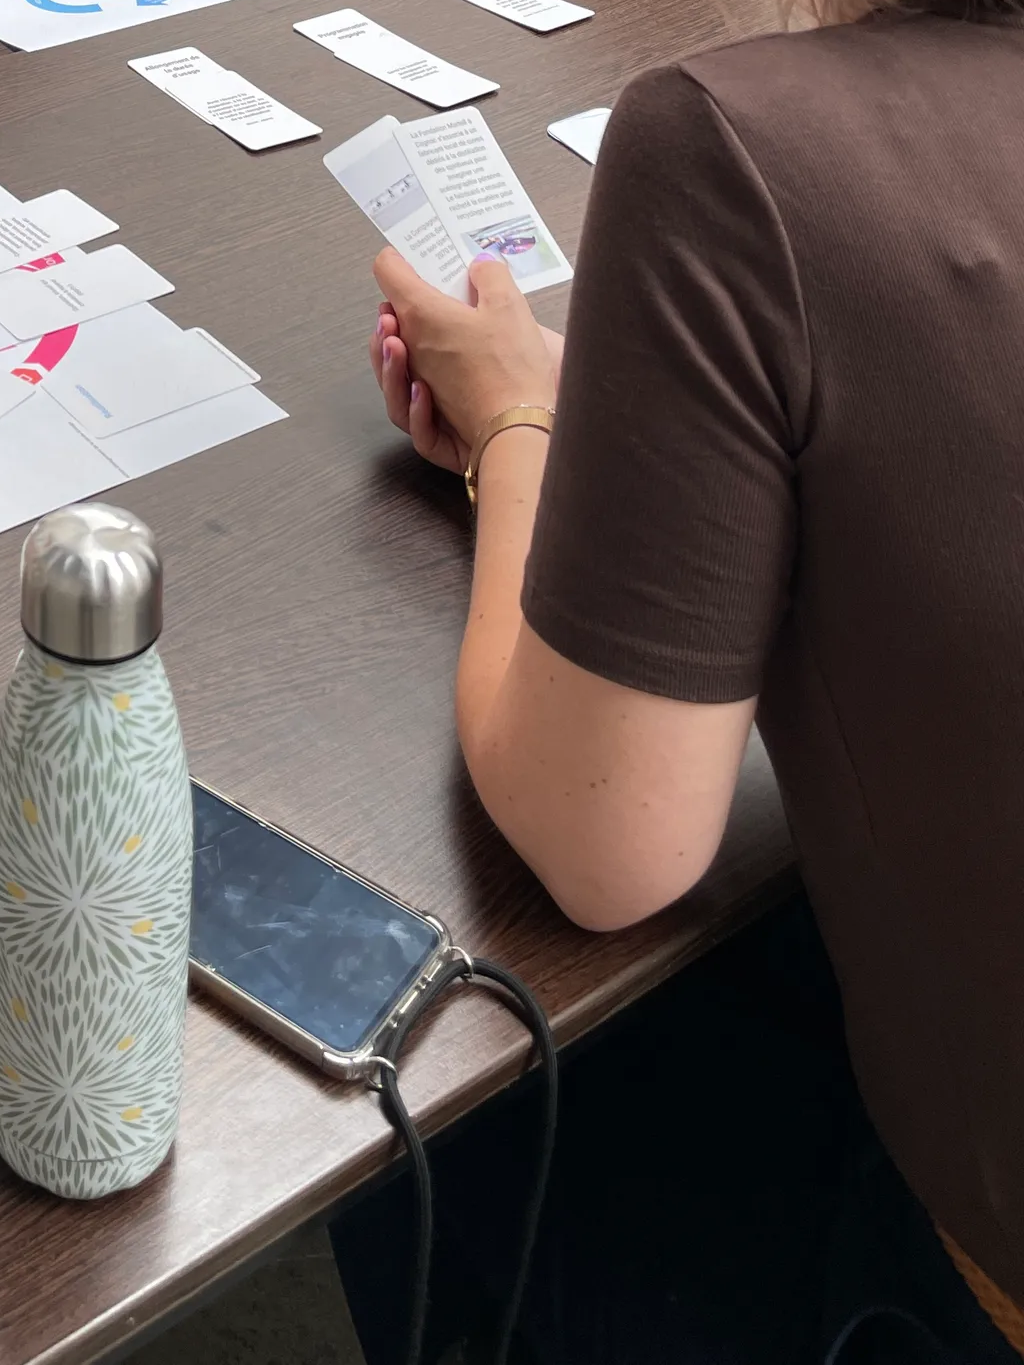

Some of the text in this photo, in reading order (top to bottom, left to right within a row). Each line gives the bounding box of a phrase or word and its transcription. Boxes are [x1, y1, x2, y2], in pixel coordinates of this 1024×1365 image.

[317, 20, 368, 39] Programmation
[144, 54, 200, 72] Allongement de
[172, 62, 194, 74] durée
[418, 124, 446, 136] Fondation
[414, 137, 437, 148] Cognac
[417, 145, 443, 157] fabricant
[443, 141, 458, 150] local
[473, 155, 487, 163] pour
[445, 194, 454, 202] Le
[477, 192, 500, 204] matière
[500, 189, 513, 197] pour
[456, 207, 485, 220] recyclage
[404, 232, 413, 242] La
[419, 249, 428, 258] de
